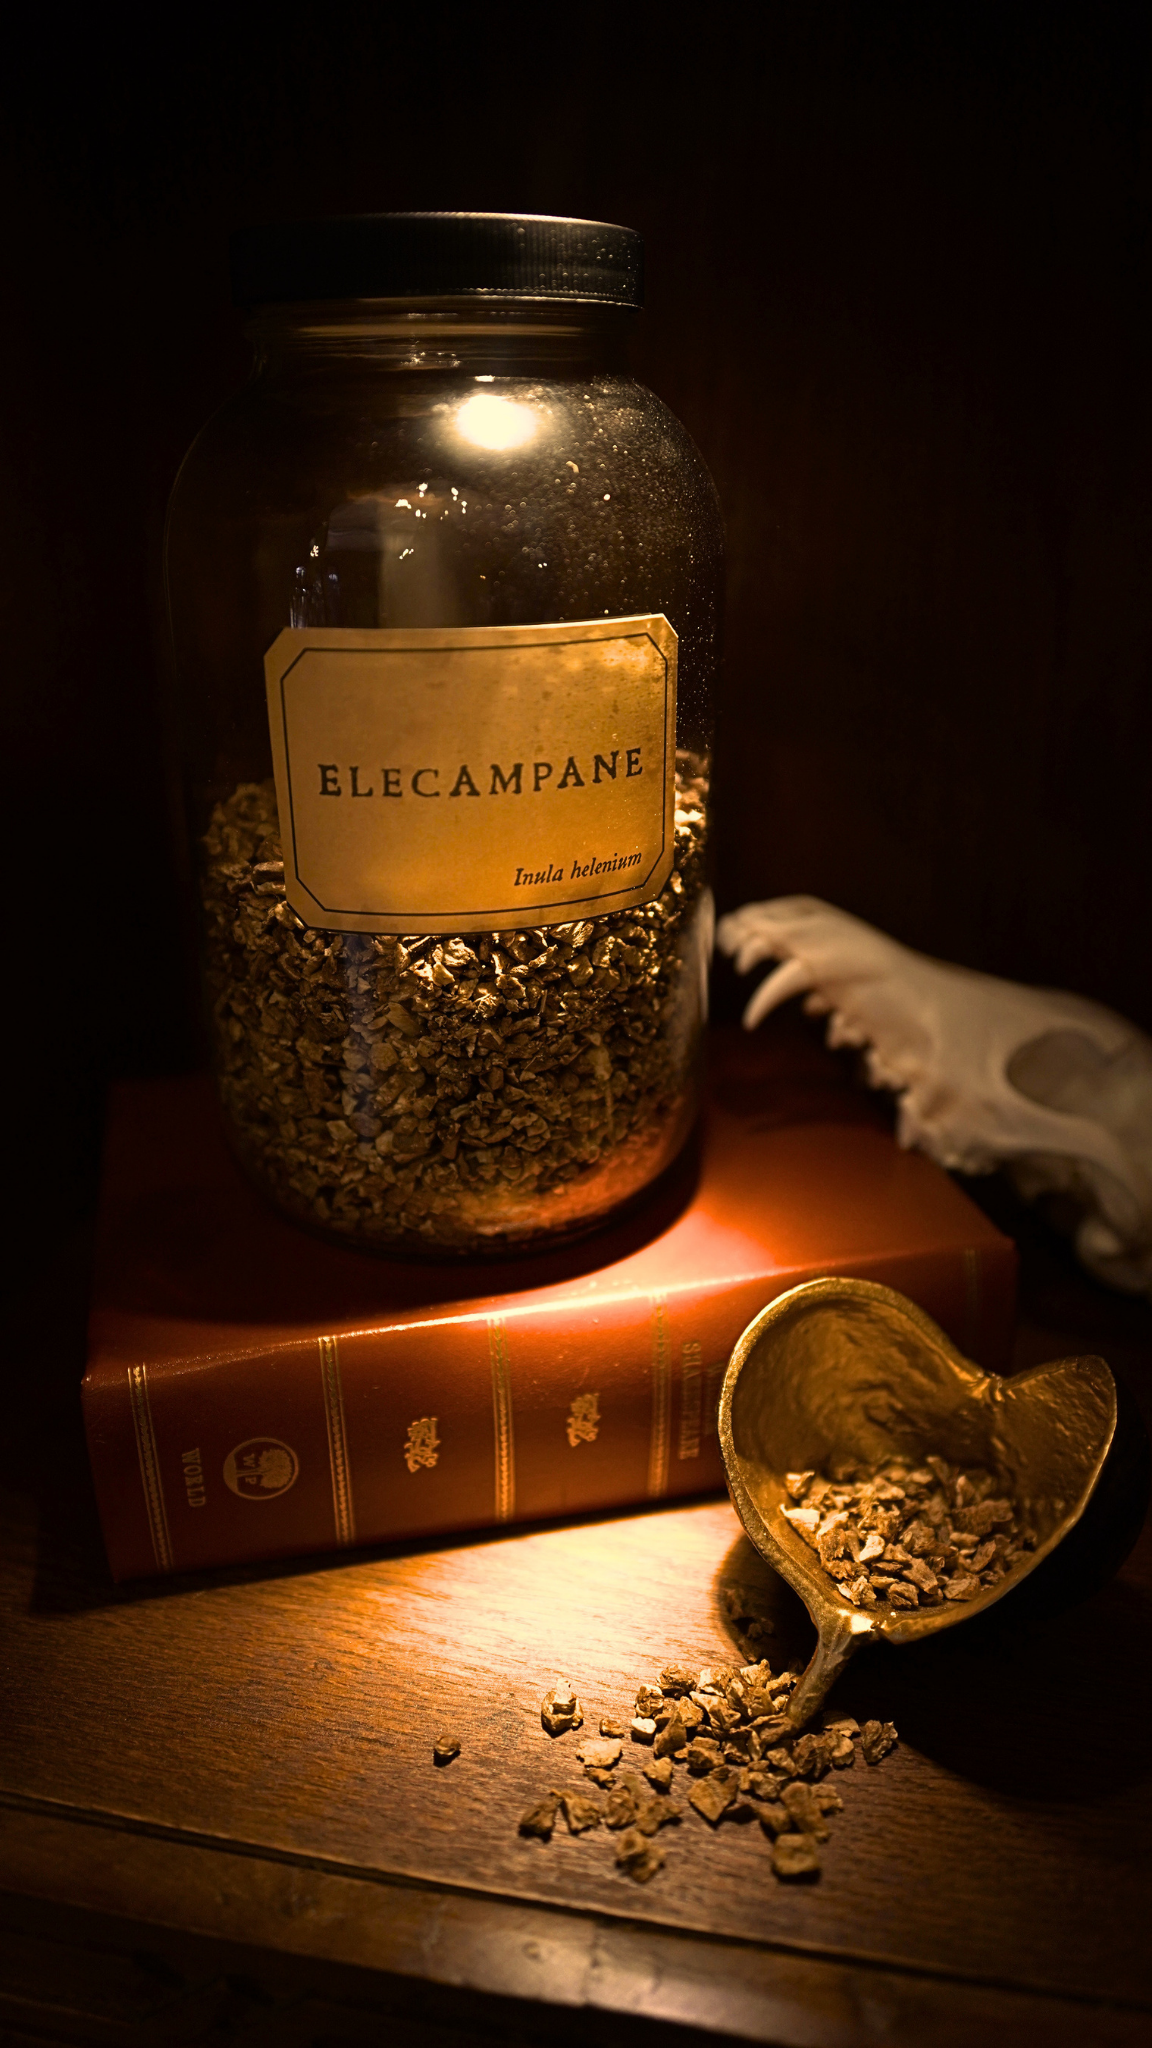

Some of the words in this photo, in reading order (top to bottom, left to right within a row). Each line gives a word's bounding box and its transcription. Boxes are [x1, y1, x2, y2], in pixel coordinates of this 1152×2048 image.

[317, 748, 643, 798] ELECAMPANE
[513, 865, 563, 887] Inula
[571, 851, 642, 879] helenium
[182, 1447, 206, 1507] WORLD
